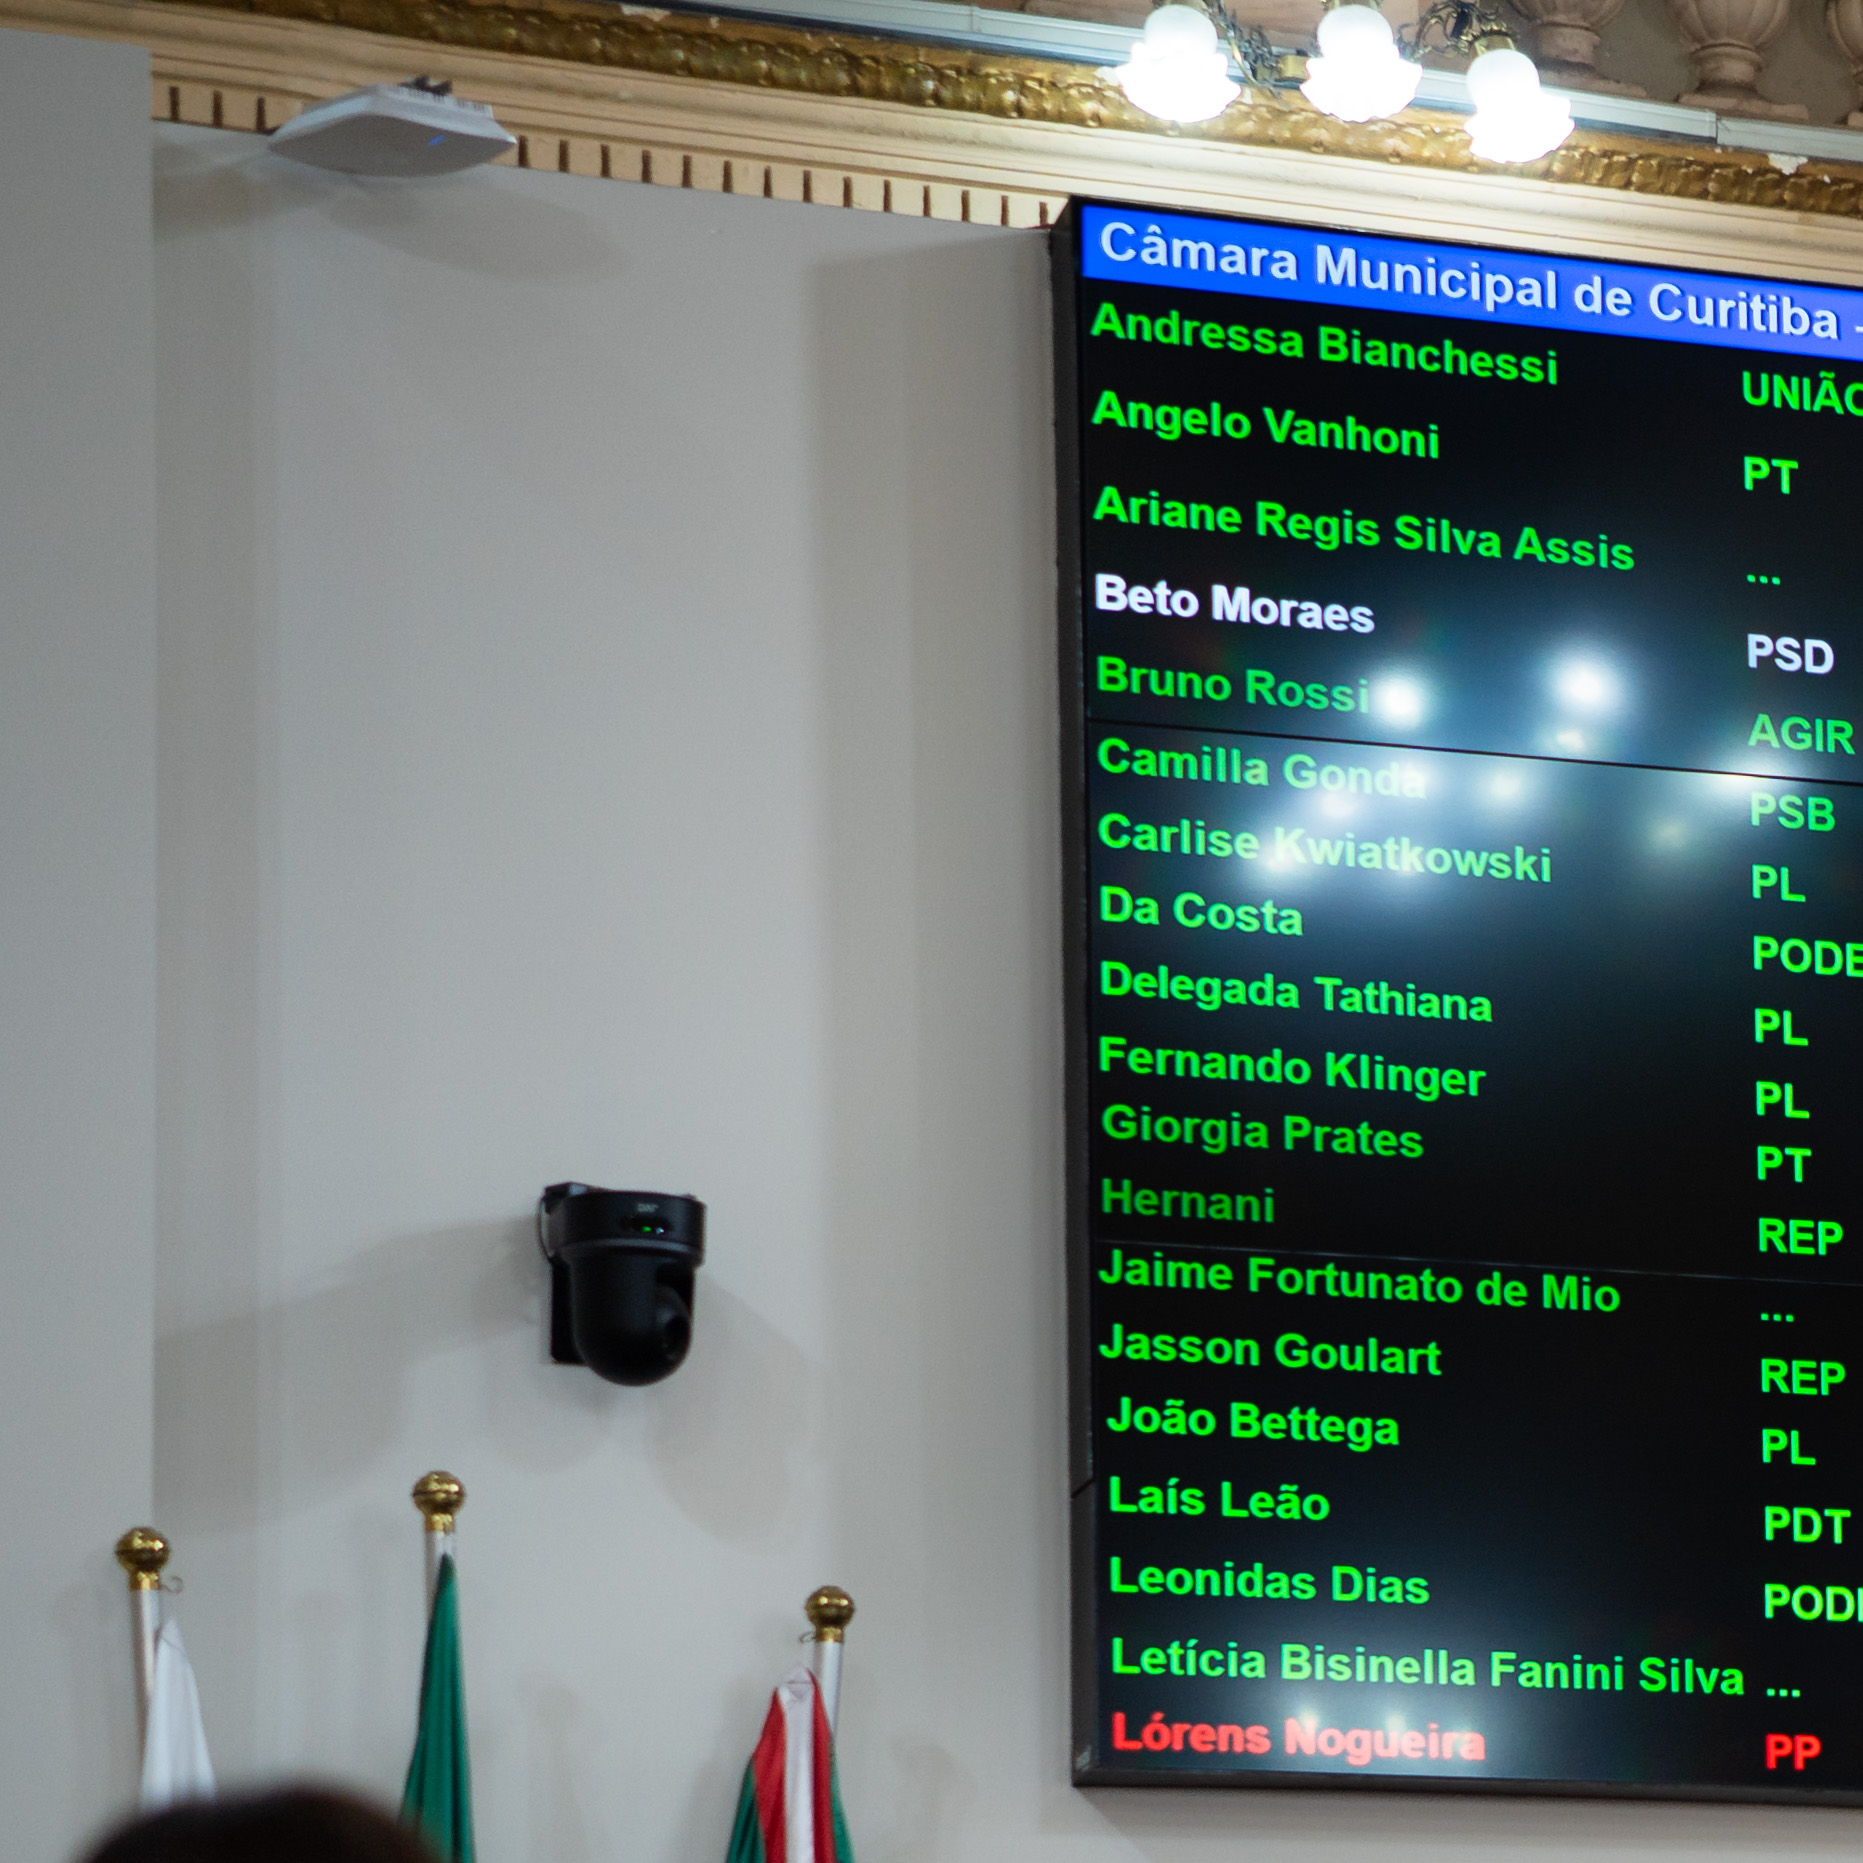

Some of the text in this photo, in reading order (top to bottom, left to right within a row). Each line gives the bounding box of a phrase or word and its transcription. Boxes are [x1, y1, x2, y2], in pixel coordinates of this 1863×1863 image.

[1101, 222, 1297, 280] Câmara
[1317, 239, 1564, 311] Municipal
[1574, 275, 1631, 316] de
[1649, 283, 1837, 339] Curitiba
[1091, 303, 1556, 384] Andressa Bianchessi
[1094, 486, 1634, 570] Ariane Regis Silva Assis
[1096, 574, 1375, 633] Beto Moraes
[1748, 634, 1834, 674] PSD
[1098, 656, 1370, 715] Bruno Rossi
[1749, 715, 1855, 755] AGIR
[1101, 886, 1304, 935] Da Costa
[1102, 961, 1491, 1021] Delegada Tathiana
[1755, 1008, 1808, 1045] PL
[1103, 1104, 1423, 1157] Giorgia Prates
[1758, 1146, 1811, 1182] PT
[1103, 1178, 1273, 1222] Hernani
[1759, 1218, 1843, 1255] REP
[1107, 1397, 1399, 1452] João Bettega
[1763, 1429, 1815, 1465] PL
[1111, 1557, 1429, 1604] Leonidas Dias
[1114, 1713, 1484, 1765] Lórens Nogueira
[1766, 1734, 1821, 1770] PP
